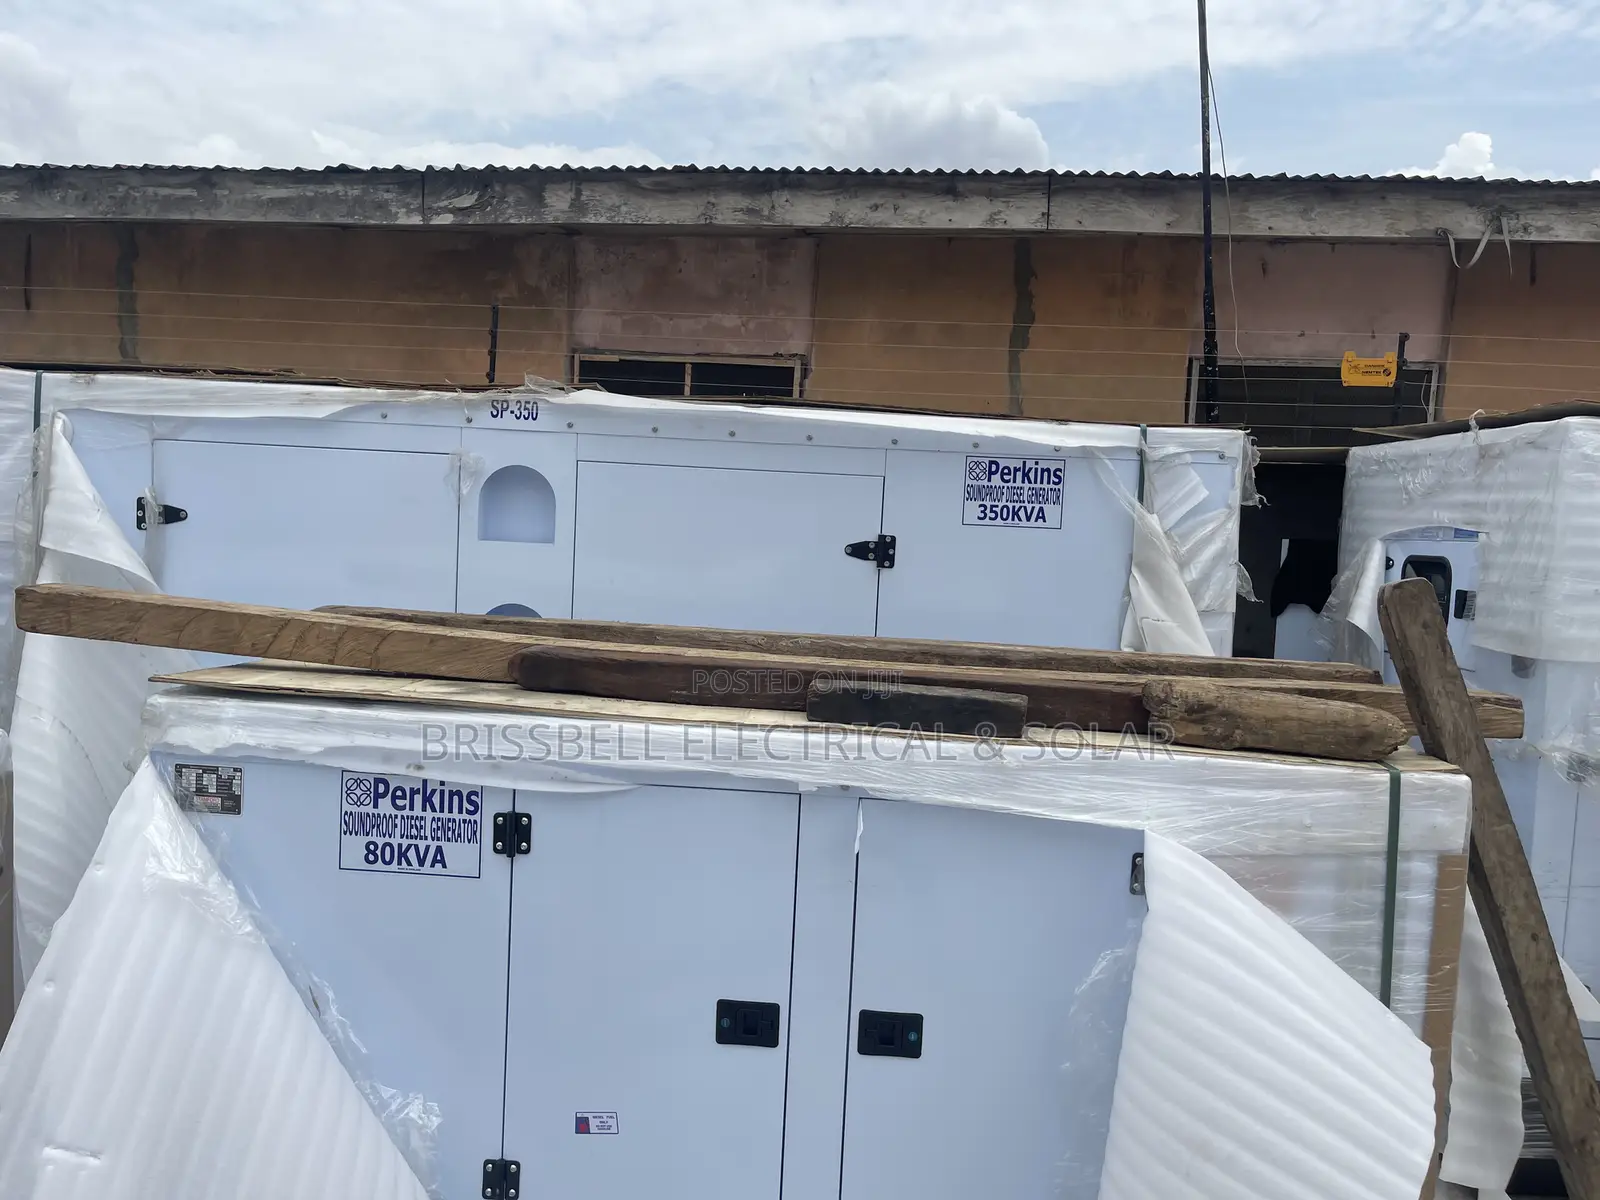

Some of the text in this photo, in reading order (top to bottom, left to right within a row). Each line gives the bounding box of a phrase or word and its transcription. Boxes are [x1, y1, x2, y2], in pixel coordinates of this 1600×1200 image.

[490, 399, 539, 421] SP-350
[987, 459, 1063, 486] Perkins
[966, 483, 1061, 506] SOUNDPROOF DIESEL GENERATOR
[977, 503, 1047, 523] 350KVA
[372, 777, 480, 816] Perkins
[343, 810, 479, 844] SOUNDPROOF DIESEL GENERATOR
[363, 840, 448, 869] 80KVA
